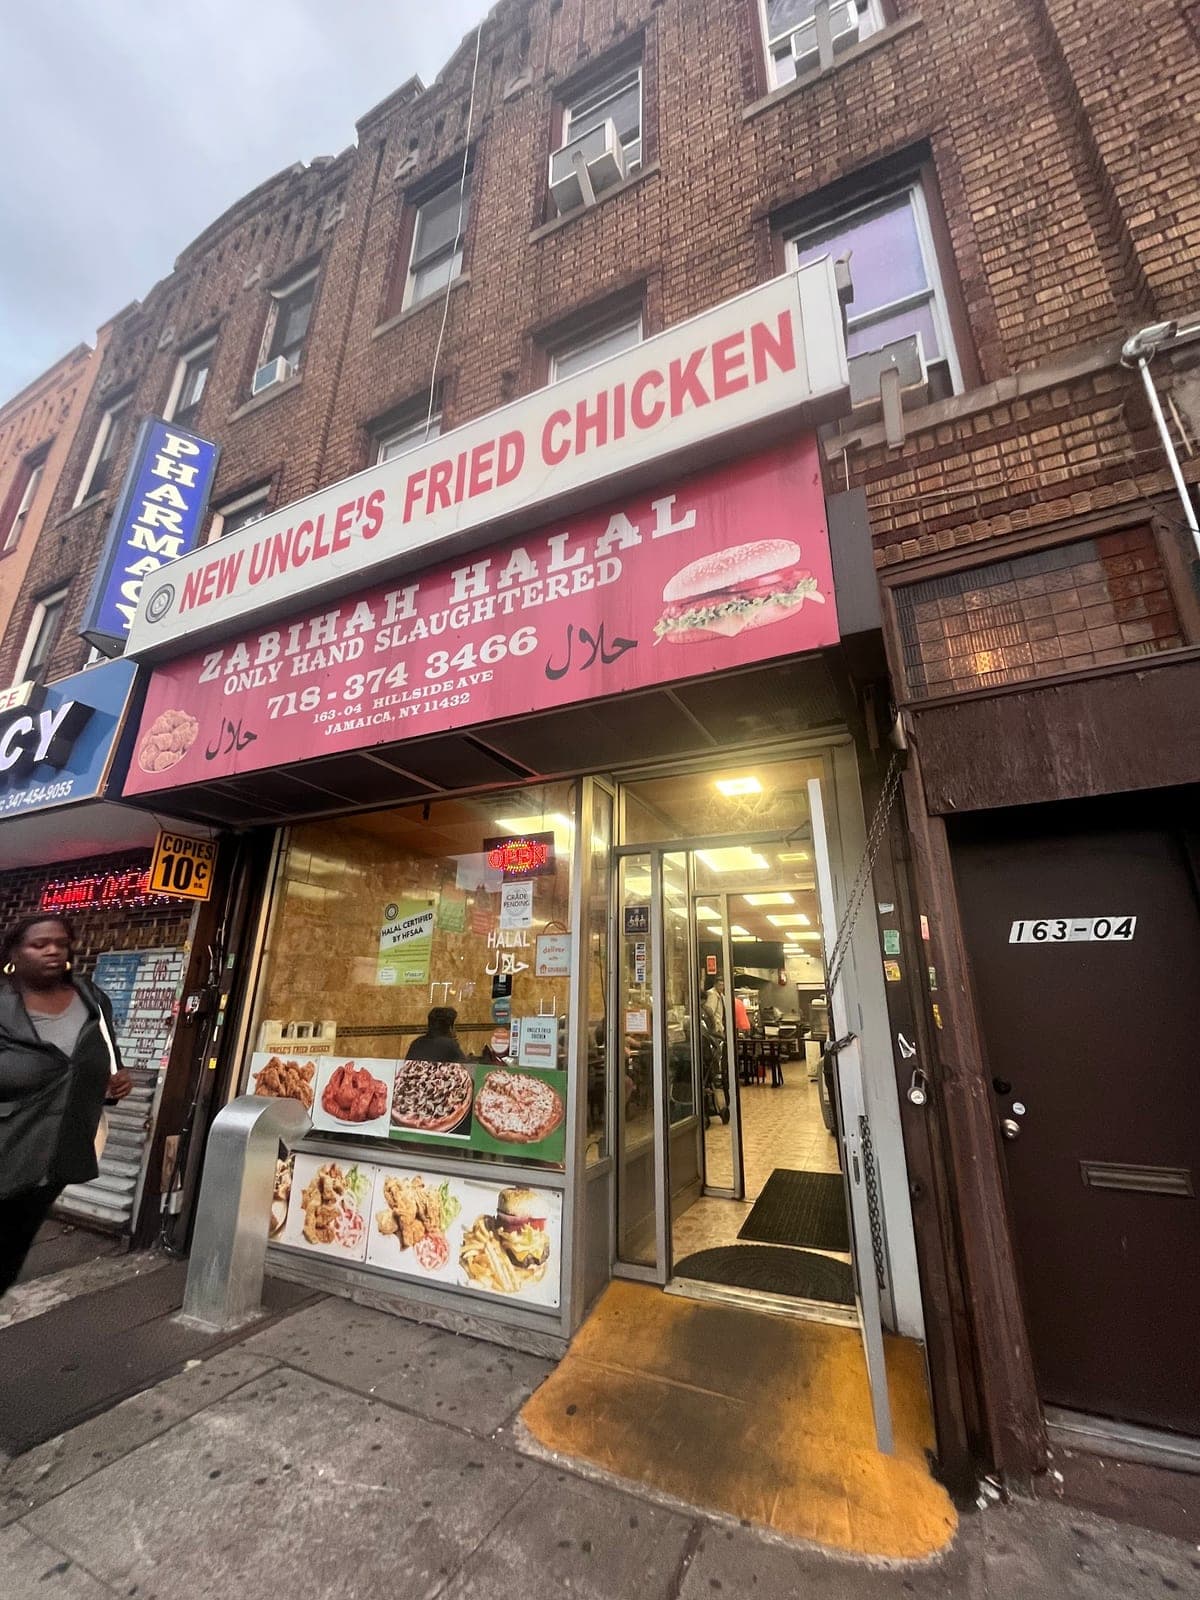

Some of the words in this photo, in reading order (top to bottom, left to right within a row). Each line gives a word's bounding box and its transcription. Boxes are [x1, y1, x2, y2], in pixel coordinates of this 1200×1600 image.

[179, 550, 245, 614] NEW
[248, 489, 385, 585] UNCLE'S
[403, 430, 525, 524] FRIED
[541, 310, 796, 465] CHICKEN
[199, 584, 419, 683] ZABIHAH
[450, 495, 696, 604] HALAL
[224, 662, 283, 695] ONLY
[291, 638, 364, 677] HAND
[374, 557, 622, 653] SLAUGHTERED
[425, 626, 538, 679] 3466
[545, 618, 638, 680] حلال
[313, 703, 362, 723] 163-04
[373, 680, 454, 709] HILLSIDE
[456, 670, 494, 688] AVE
[325, 712, 395, 735] JAMAICA,
[399, 705, 424, 719] NY
[424, 692, 470, 713] 11432
[0, 700, 75, 771] CY
[205, 717, 258, 760] حلال
[163, 836, 213, 860] COPIES
[488, 844, 548, 869] OPEN
[381, 924, 402, 936] HALAL
[402, 913, 433, 928] CERTIFIED
[503, 900, 530, 908] PENDING
[402, 926, 424, 939] HFSAA
[487, 930, 531, 948] HALAL
[1016, 918, 1133, 942] 163-04
[485, 950, 530, 976] حلال
